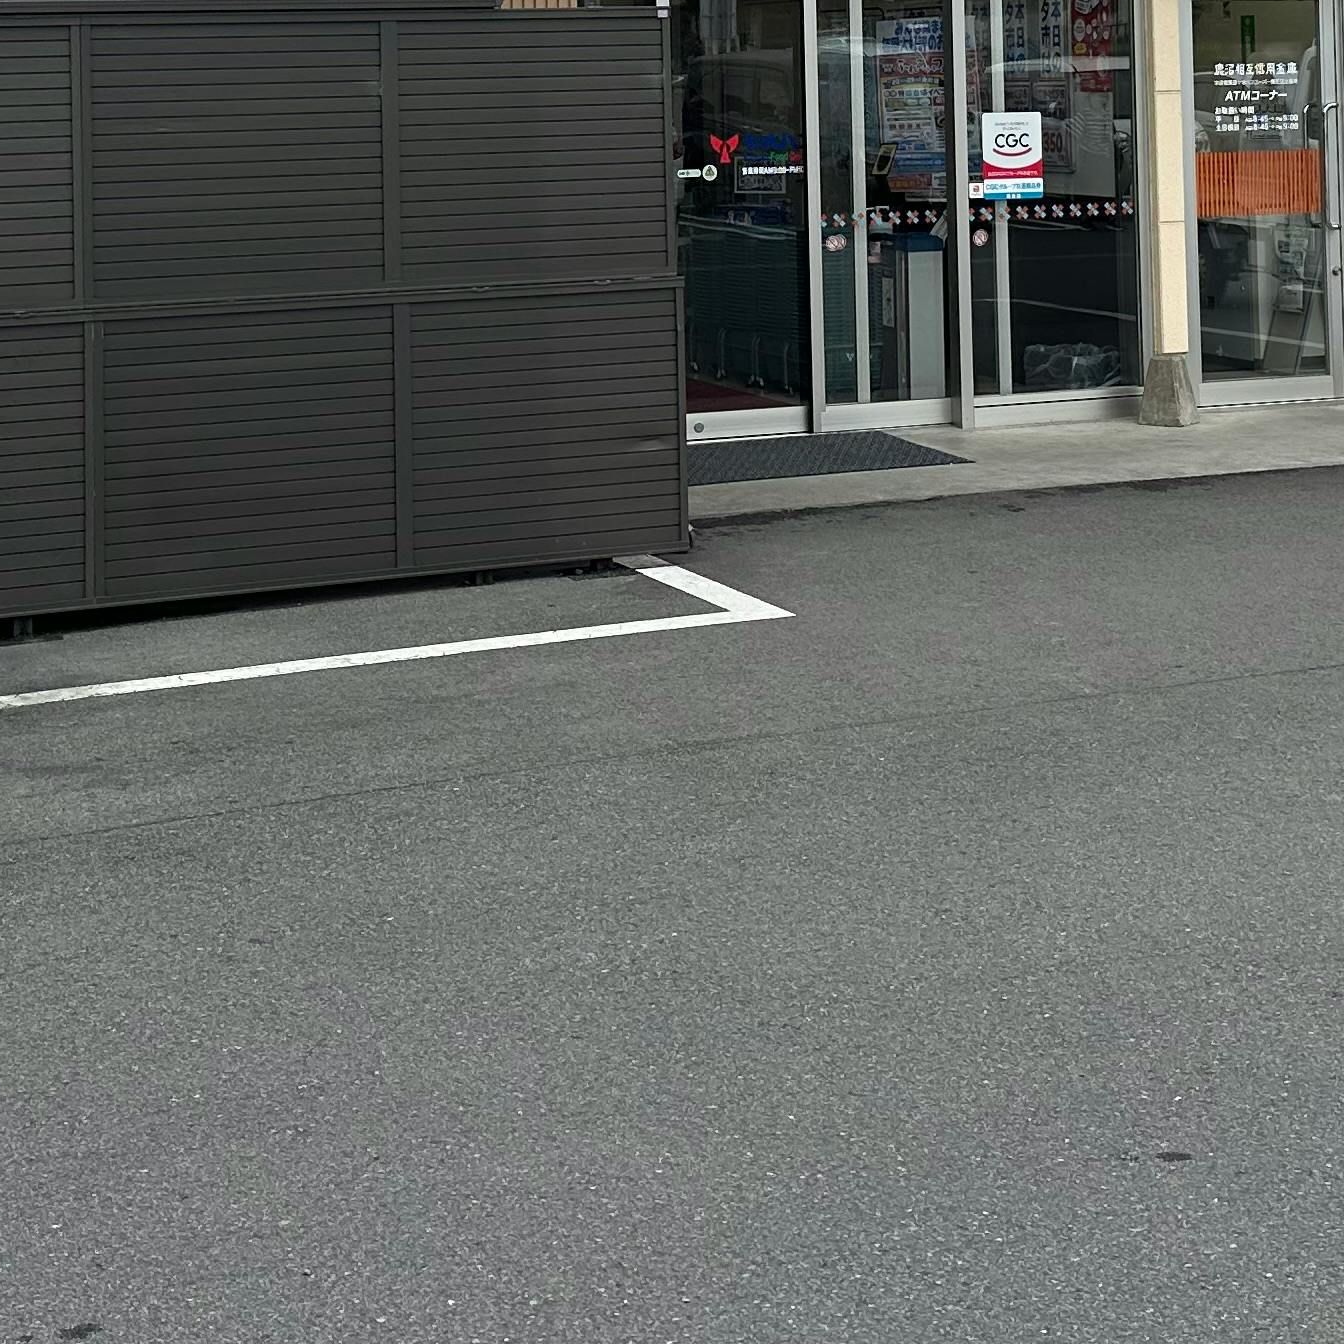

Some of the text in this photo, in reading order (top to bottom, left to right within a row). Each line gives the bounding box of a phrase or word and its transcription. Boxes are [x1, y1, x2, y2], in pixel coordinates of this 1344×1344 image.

[1224, 90, 1287, 101] ATMコーナー
[994, 133, 1030, 148] CGC
